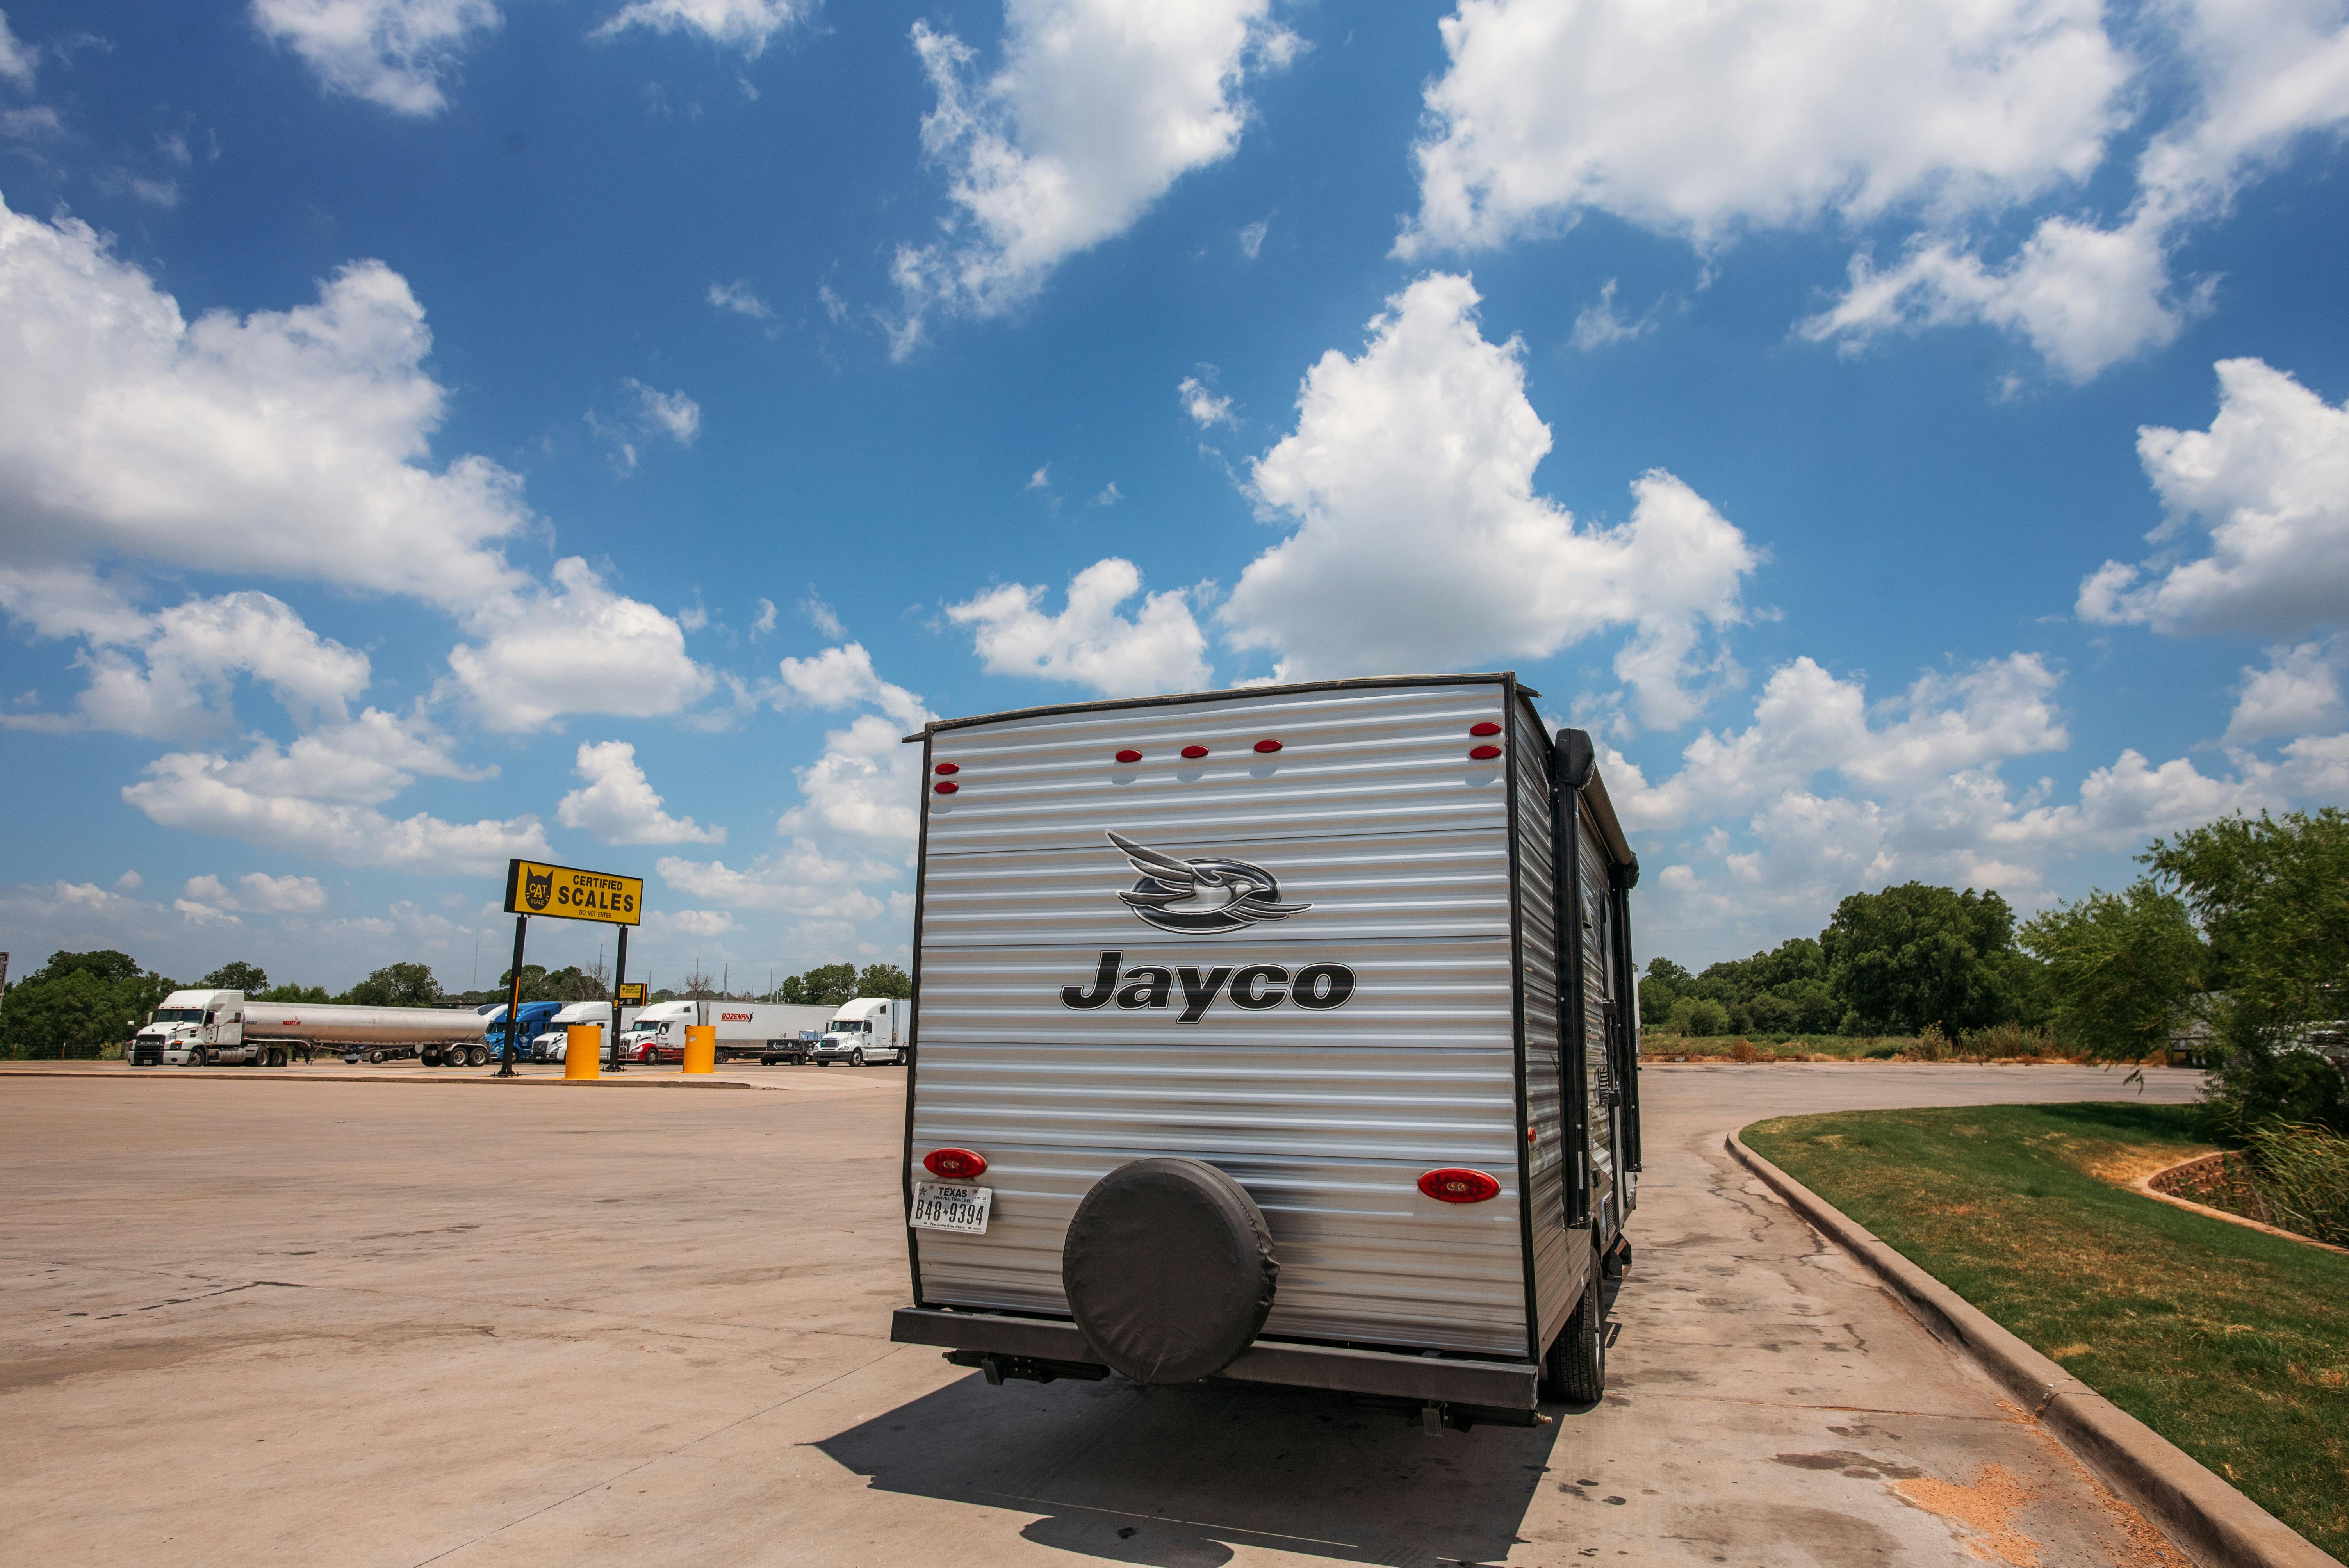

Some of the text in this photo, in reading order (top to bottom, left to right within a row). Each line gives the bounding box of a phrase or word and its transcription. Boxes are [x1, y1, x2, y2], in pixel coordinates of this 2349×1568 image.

[529, 883, 547, 898] CAT
[573, 875, 623, 891] CERTIFIED
[558, 886, 634, 912] SCALES
[1060, 950, 1357, 1025] Jayco
[938, 1187, 967, 1198] TEXAS
